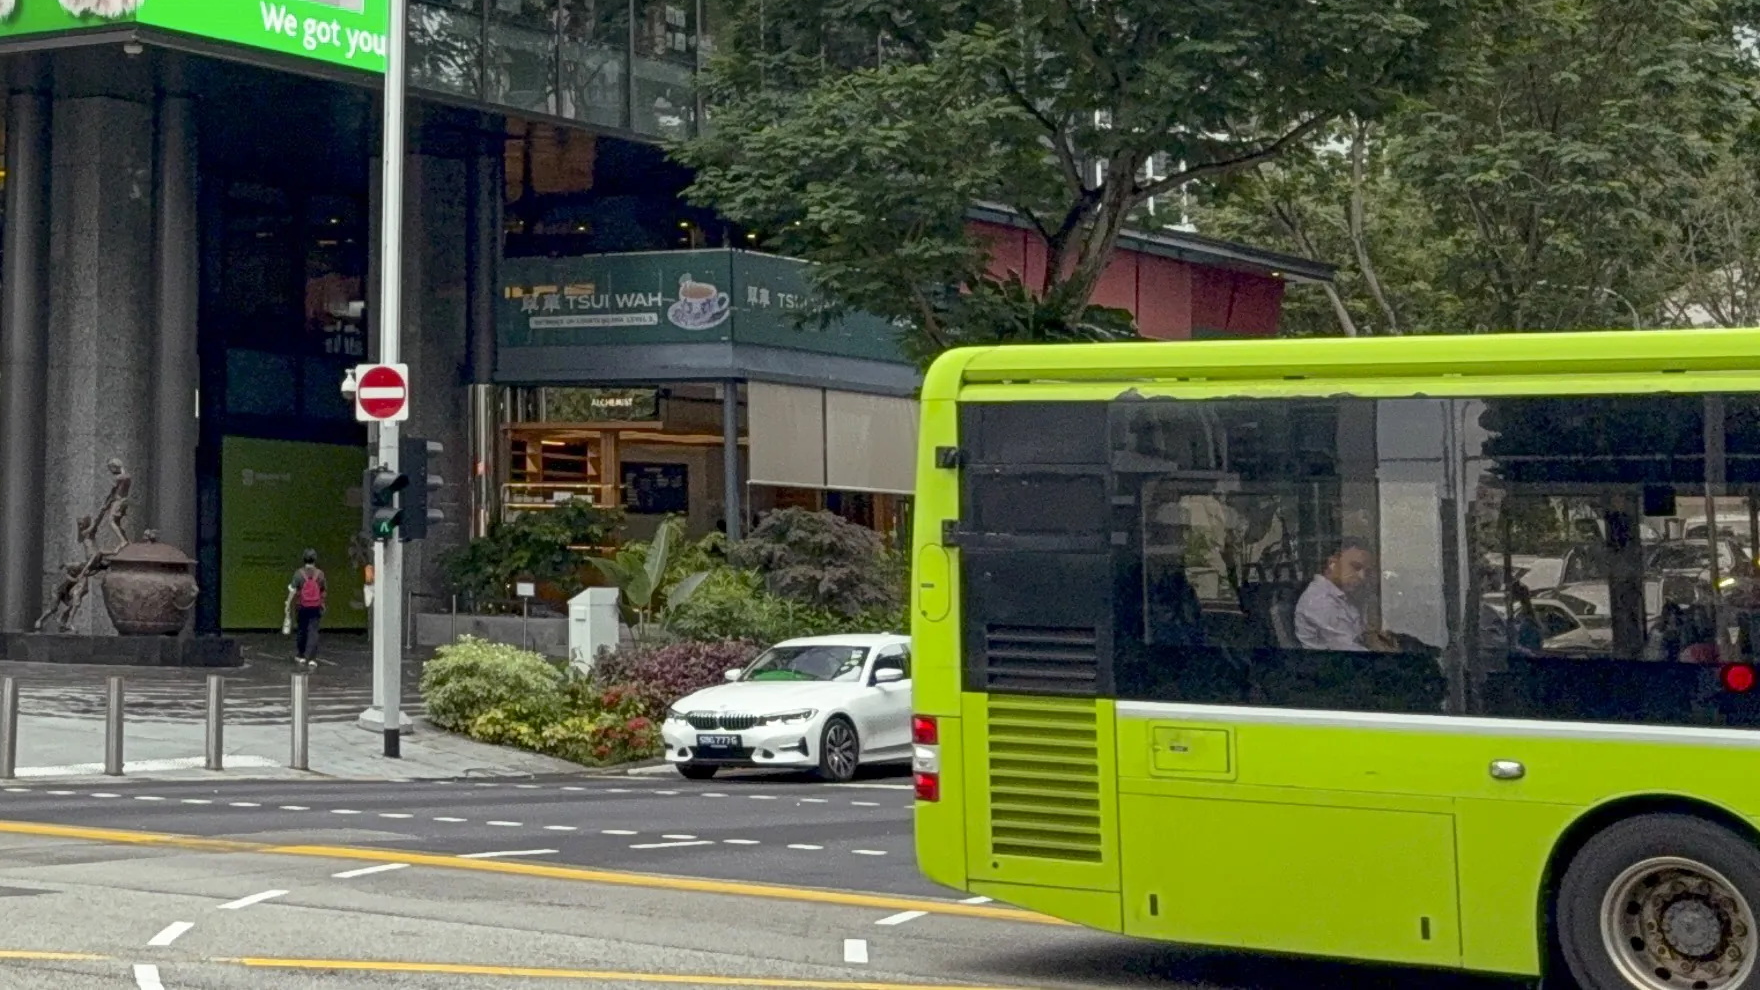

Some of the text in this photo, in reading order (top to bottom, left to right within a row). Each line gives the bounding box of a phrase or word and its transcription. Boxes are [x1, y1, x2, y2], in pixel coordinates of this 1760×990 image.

[260, 0, 387, 59] We got you
[567, 292, 663, 310] TSUI WAH
[591, 397, 633, 407] ALCHEMIST
